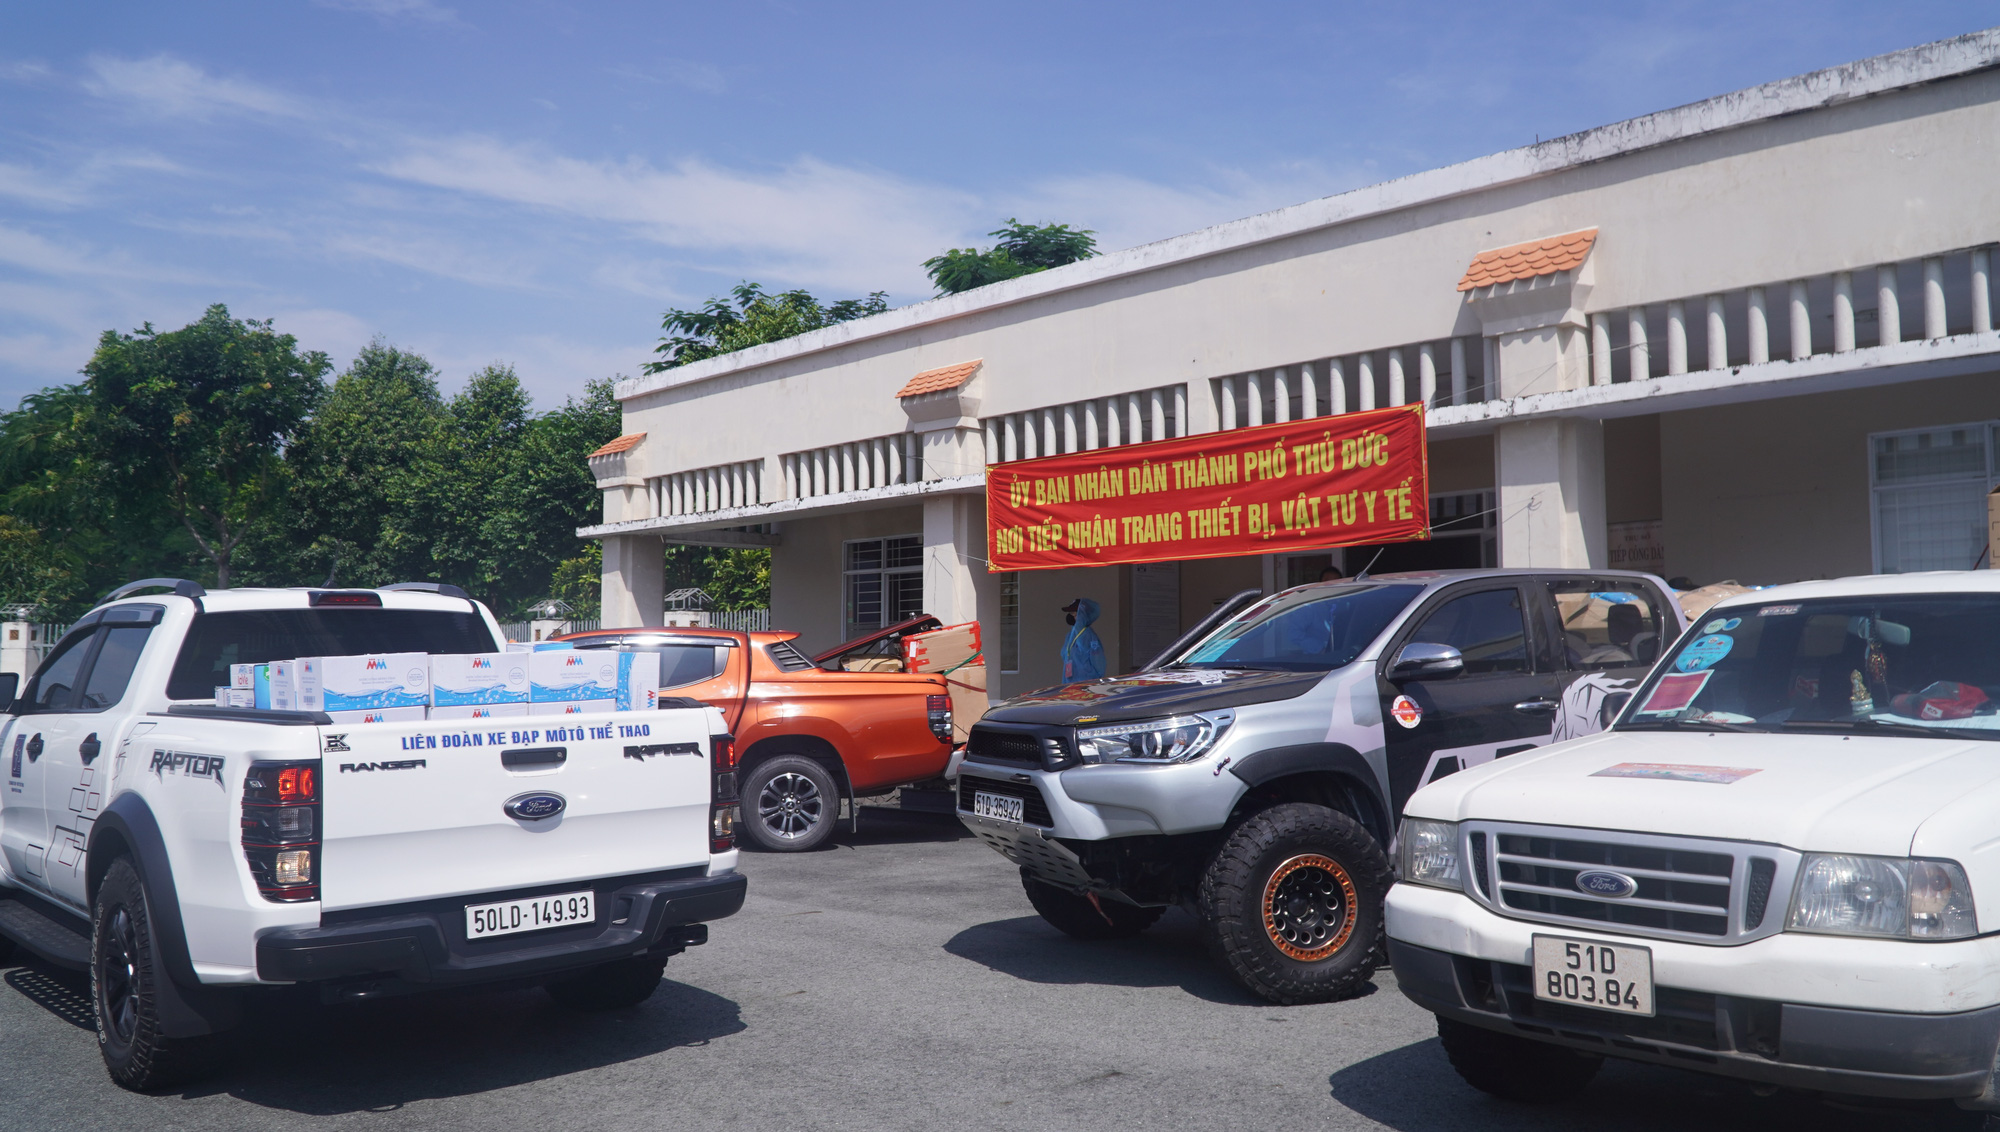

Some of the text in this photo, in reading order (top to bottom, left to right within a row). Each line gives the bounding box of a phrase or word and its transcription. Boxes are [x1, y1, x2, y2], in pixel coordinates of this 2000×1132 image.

[1010, 429, 1389, 508] ỦY BAN NHÂN DÂN THÀNH PHỐ THỦ ĐỨC
[996, 476, 1414, 555] NƠI TIẾP NHẬN TRANG THIẾT BỊ, VẬT TƯ Y TẾ
[401, 733, 437, 751] LIÊN
[442, 731, 483, 748] ĐOÀN
[488, 731, 507, 745] XE
[511, 730, 540, 746] ĐẠP
[589, 721, 614, 740] THỂ
[618, 724, 651, 738] THAO
[150, 748, 226, 793] RAPTOR
[339, 759, 427, 774] RANGER
[526, 800, 553, 813] Ford
[1590, 876, 1618, 892] Ford
[474, 896, 589, 934] 50LD-149.93
[1565, 942, 1616, 974] 51D
[1547, 970, 1639, 1010] 803.84
